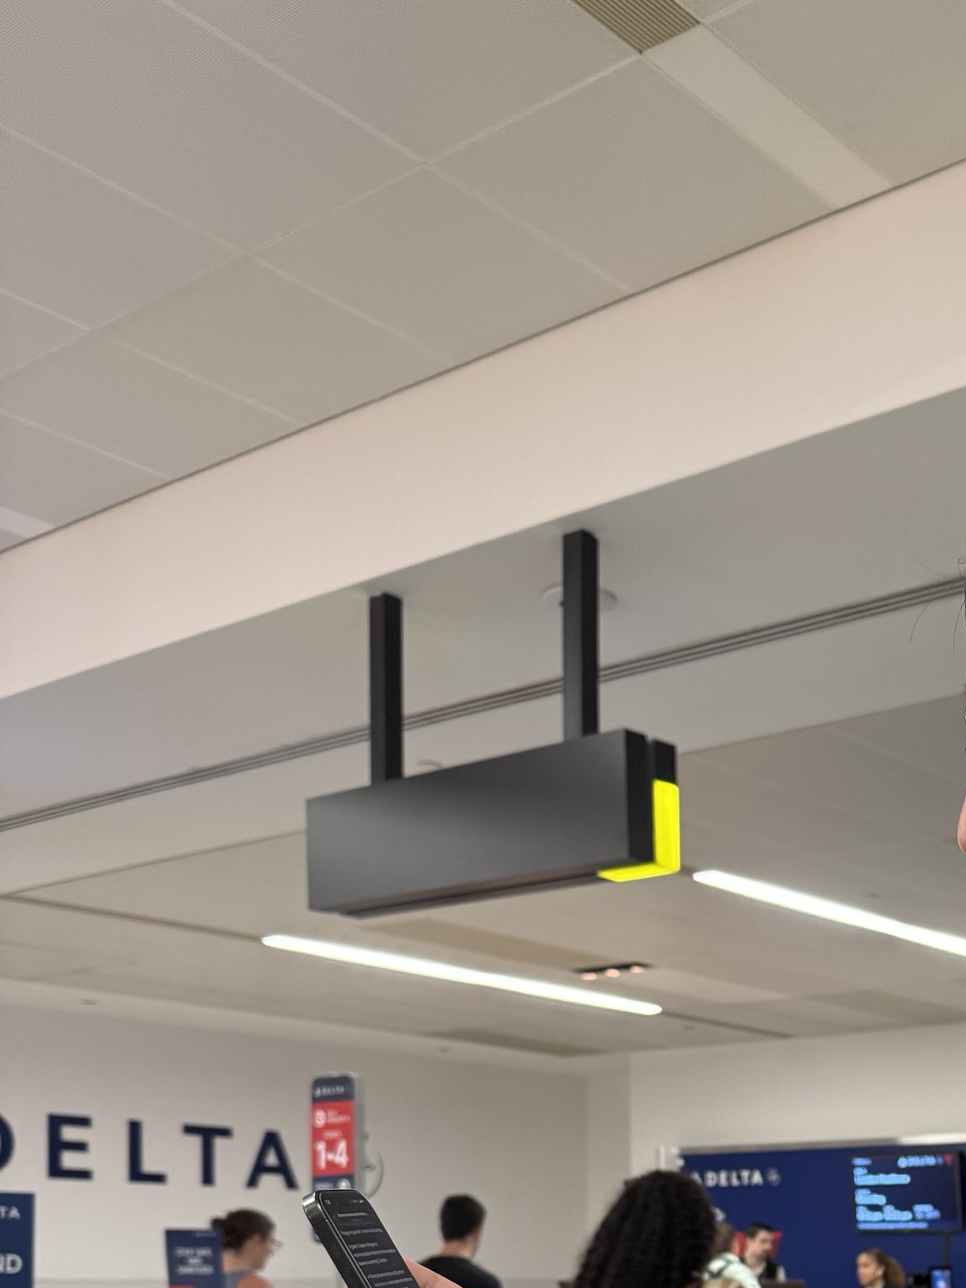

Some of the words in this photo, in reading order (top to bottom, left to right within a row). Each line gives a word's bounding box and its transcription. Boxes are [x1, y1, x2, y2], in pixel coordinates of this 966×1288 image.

[0, 1112, 299, 1190] ELTA
[314, 1139, 349, 1170] 1-4
[704, 1169, 764, 1187] DELTA
